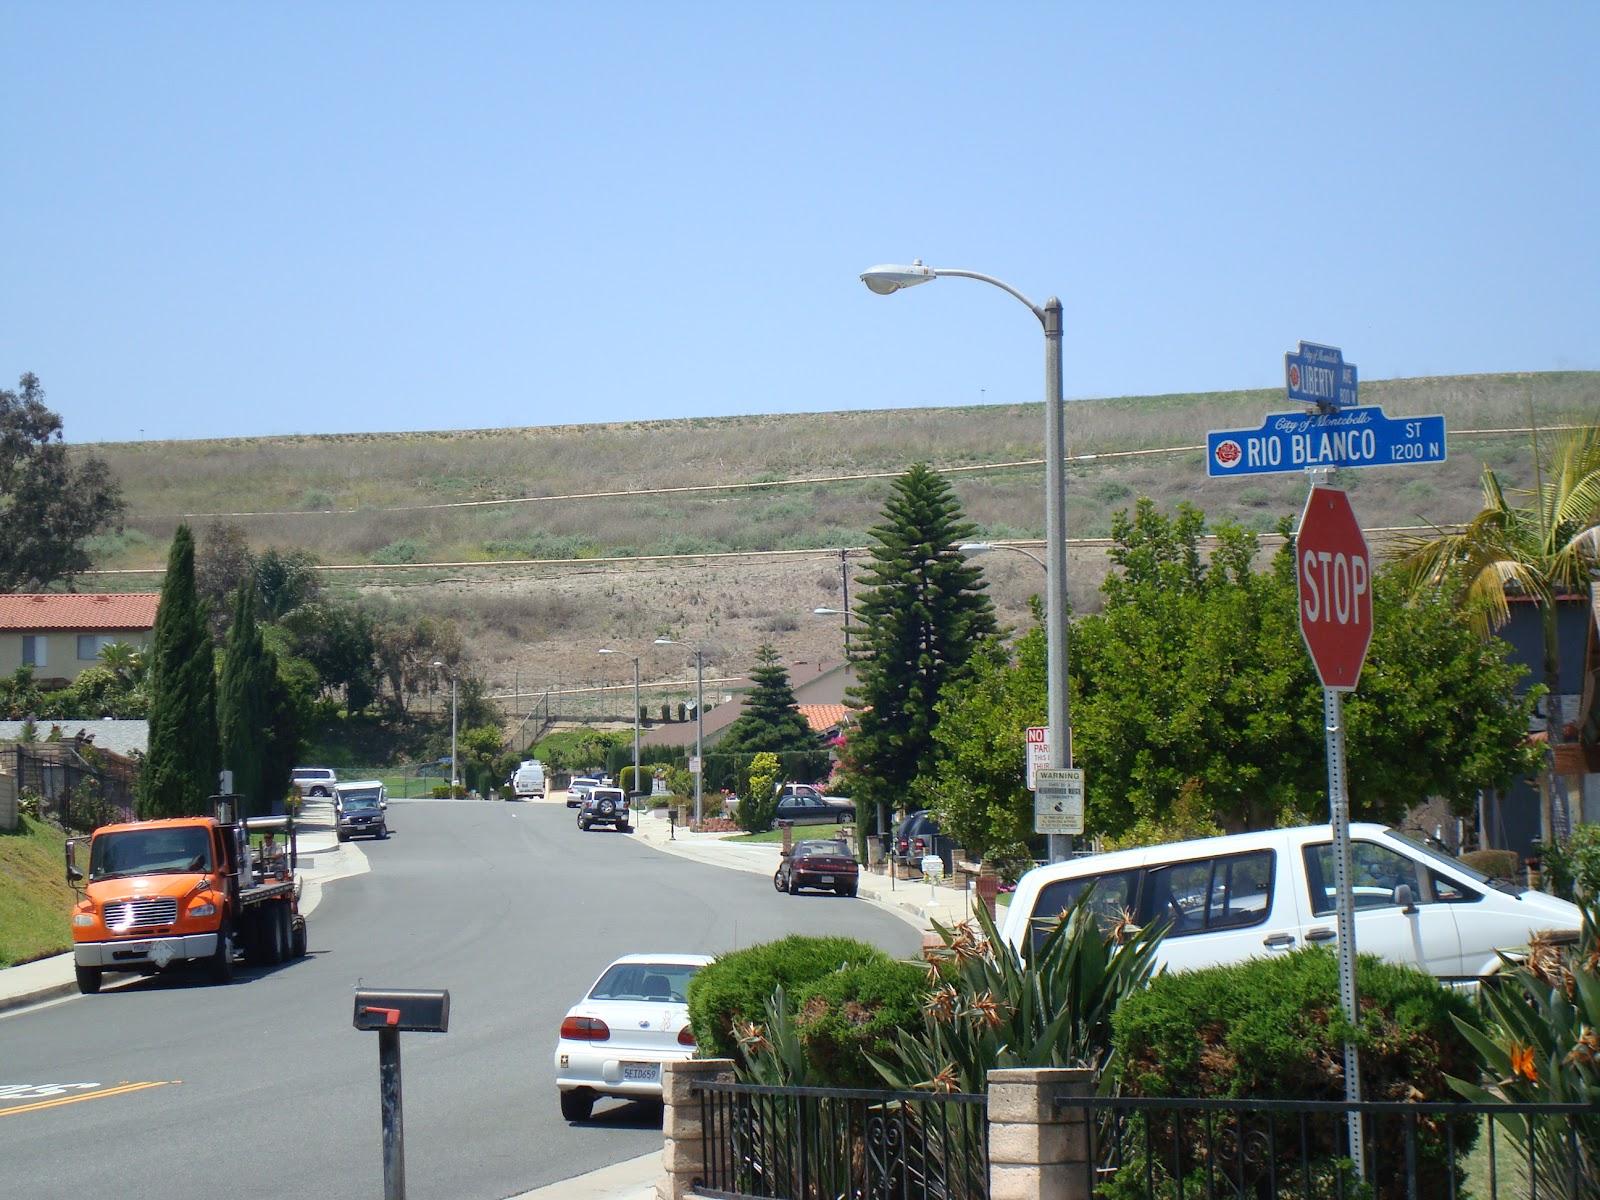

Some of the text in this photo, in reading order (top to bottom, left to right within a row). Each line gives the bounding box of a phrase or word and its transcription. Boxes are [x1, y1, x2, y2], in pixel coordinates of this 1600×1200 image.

[1301, 365, 1335, 398] LIBERTY
[1342, 368, 1353, 384] AVE
[1275, 411, 1373, 434] City of Montebello
[1405, 422, 1422, 439] ST
[1248, 428, 1376, 467] RIO BLANCO
[1391, 442, 1440, 461] 1200 N
[1303, 549, 1367, 625] STOP
[1028, 729, 1043, 742] NO
[1034, 744, 1050, 753] PAR
[1040, 772, 1080, 780] WARNING
